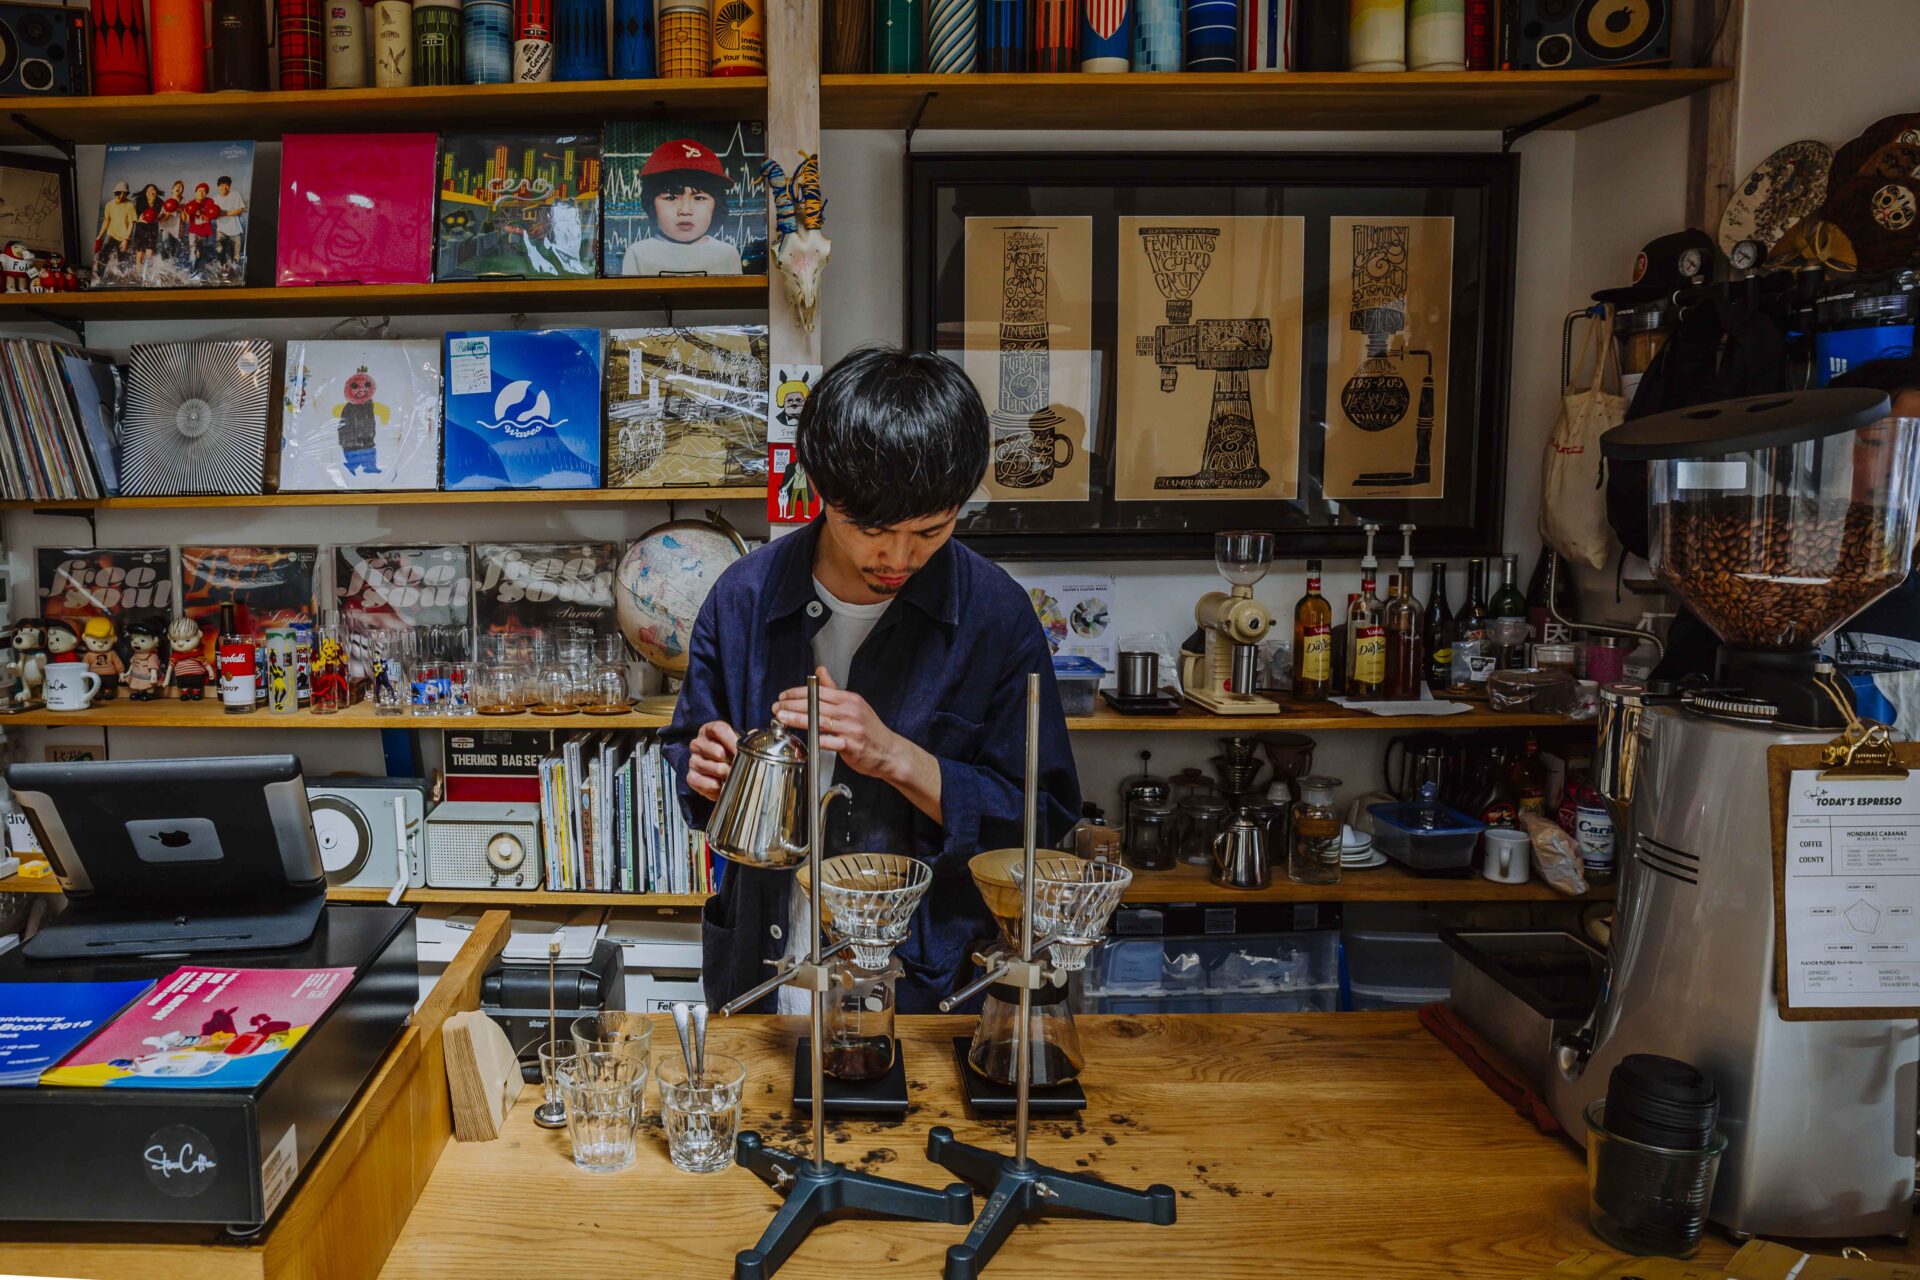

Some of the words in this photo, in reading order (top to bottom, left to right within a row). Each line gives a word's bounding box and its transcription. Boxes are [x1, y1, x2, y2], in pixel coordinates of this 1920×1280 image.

[521, 67, 533, 81] The
[529, 43, 550, 68] Genuine
[1142, 235, 1183, 252] FEWER
[1184, 235, 1217, 252] FINES
[1146, 251, 1212, 273] IMPROVED
[1163, 257, 1192, 272] CUP
[1199, 326, 1271, 351] ESPRESSO
[1001, 389, 1049, 412] PLUNGE
[504, 425, 543, 438] Waves
[39, 560, 157, 597] free
[336, 557, 456, 597] free
[63, 579, 172, 609] soul
[361, 577, 472, 608] soul
[452, 753, 498, 767] THERMOS
[501, 754, 523, 767] BAG
[1816, 797, 1855, 806] TODAY'S
[1857, 797, 1902, 806] ESPRESSO
[1799, 840, 1823, 848] COFFEE
[1798, 856, 1825, 864] COUNTY
[528, 1020, 546, 1028] star
